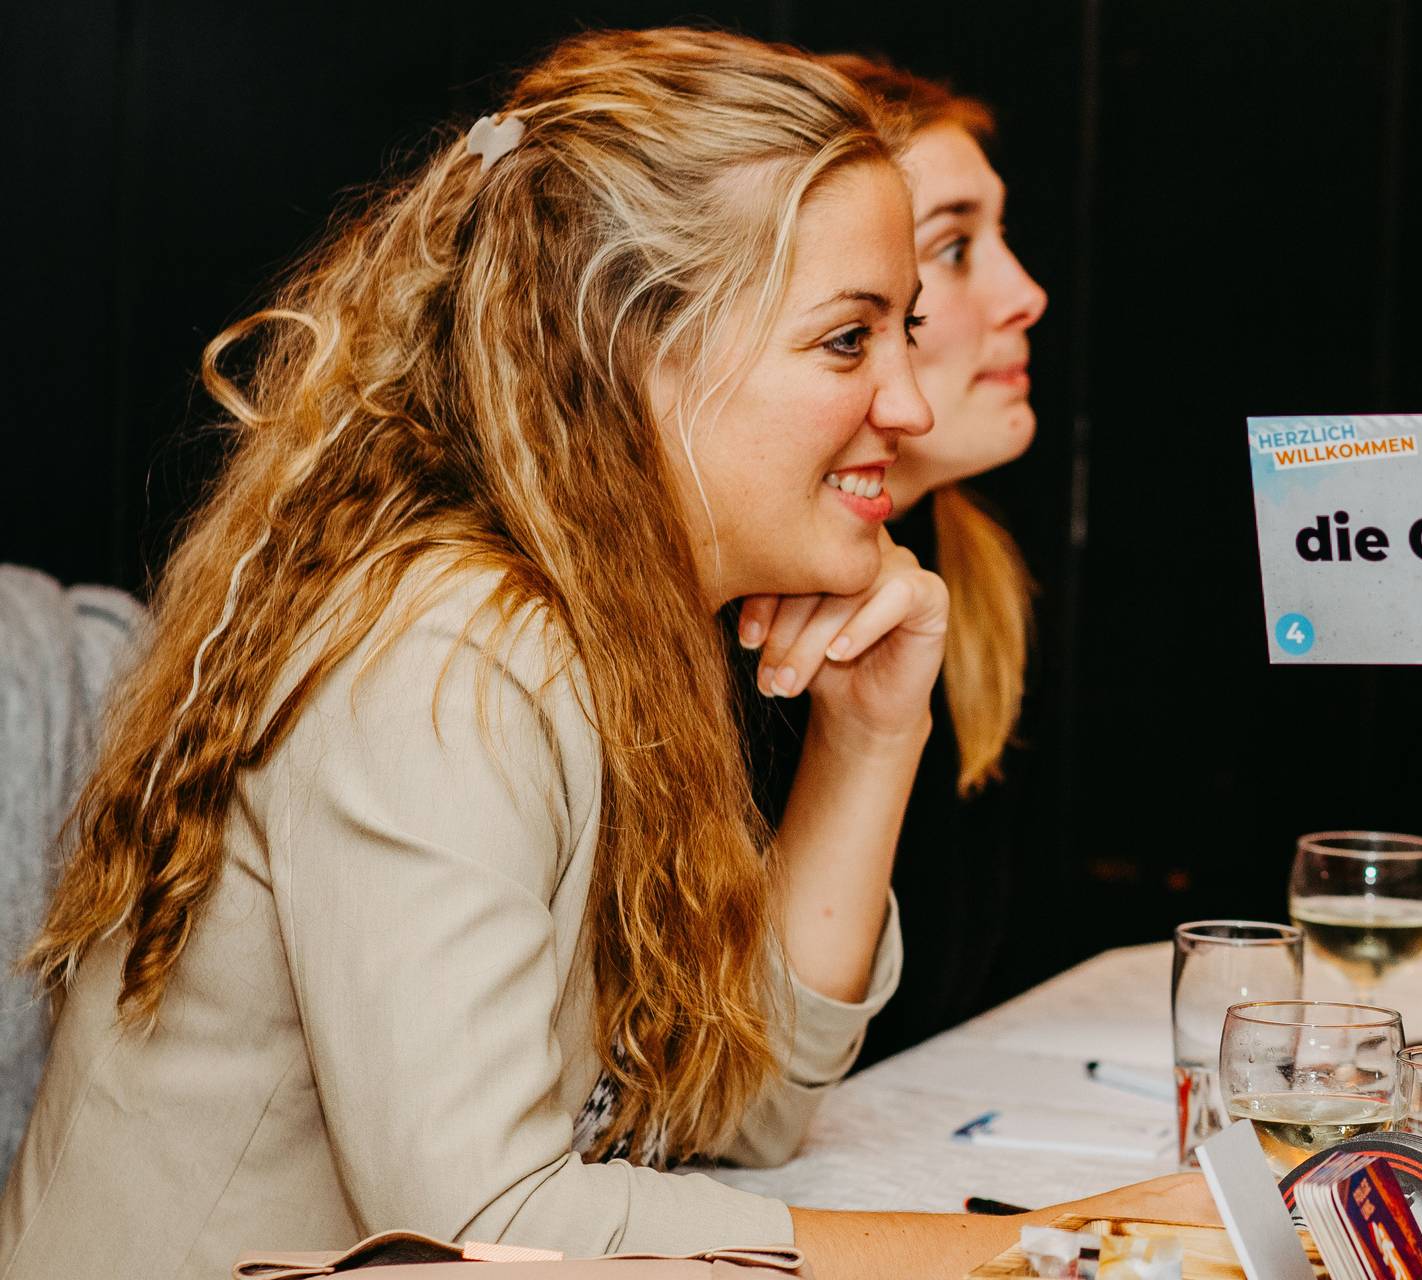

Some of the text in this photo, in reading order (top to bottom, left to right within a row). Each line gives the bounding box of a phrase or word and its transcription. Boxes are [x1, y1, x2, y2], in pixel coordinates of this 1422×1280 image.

[1258, 425, 1355, 449] HERZLICH
[1276, 437, 1415, 465] WILLKOMMEN
[1295, 510, 1389, 562] die
[1286, 622, 1305, 643] 4
